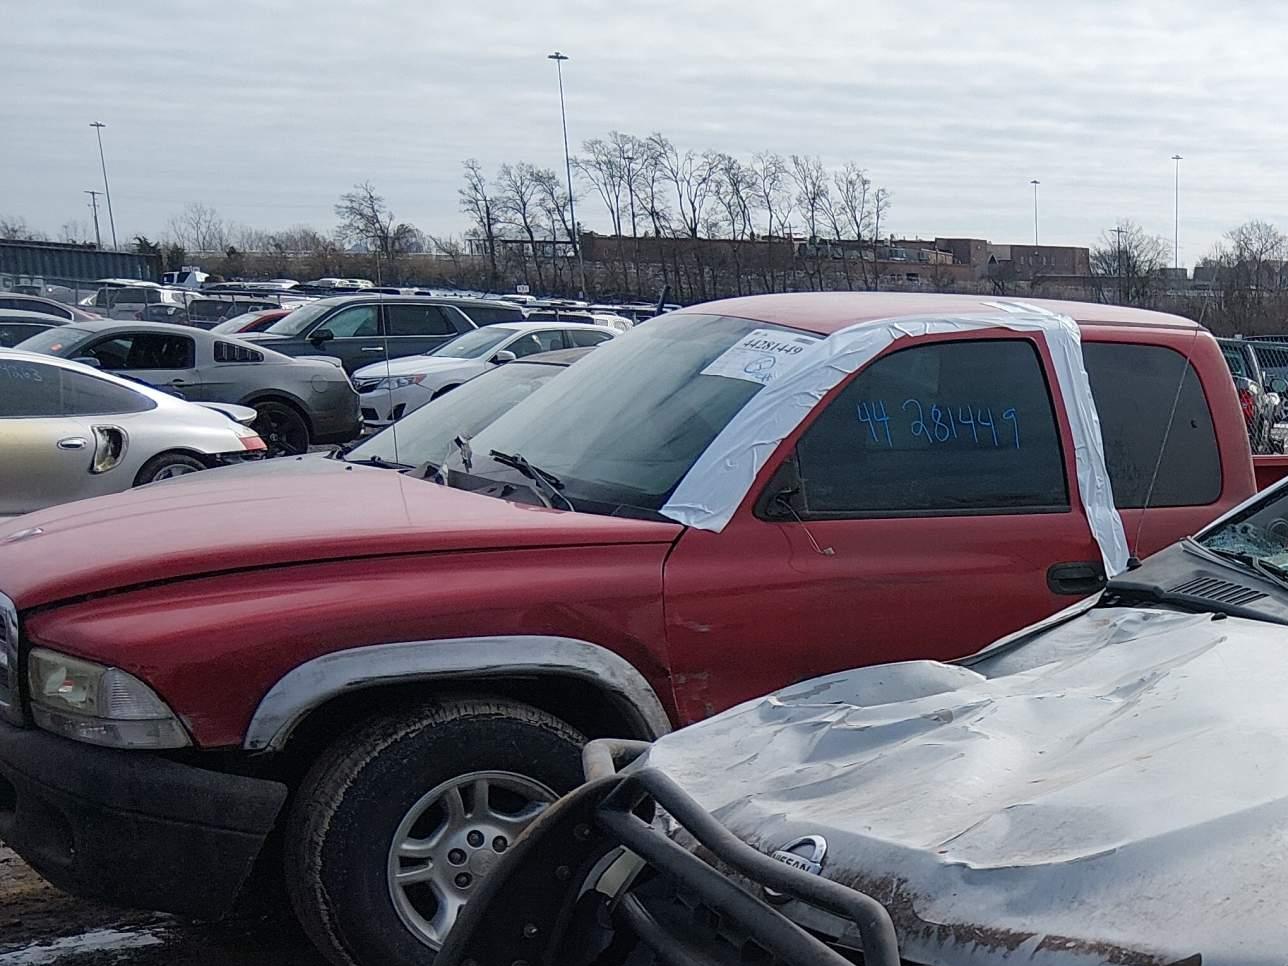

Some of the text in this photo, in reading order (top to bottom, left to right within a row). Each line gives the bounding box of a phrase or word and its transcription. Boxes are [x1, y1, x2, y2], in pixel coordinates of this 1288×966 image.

[743, 338, 804, 355] 44281449
[857, 399, 1020, 449] 44 281449
